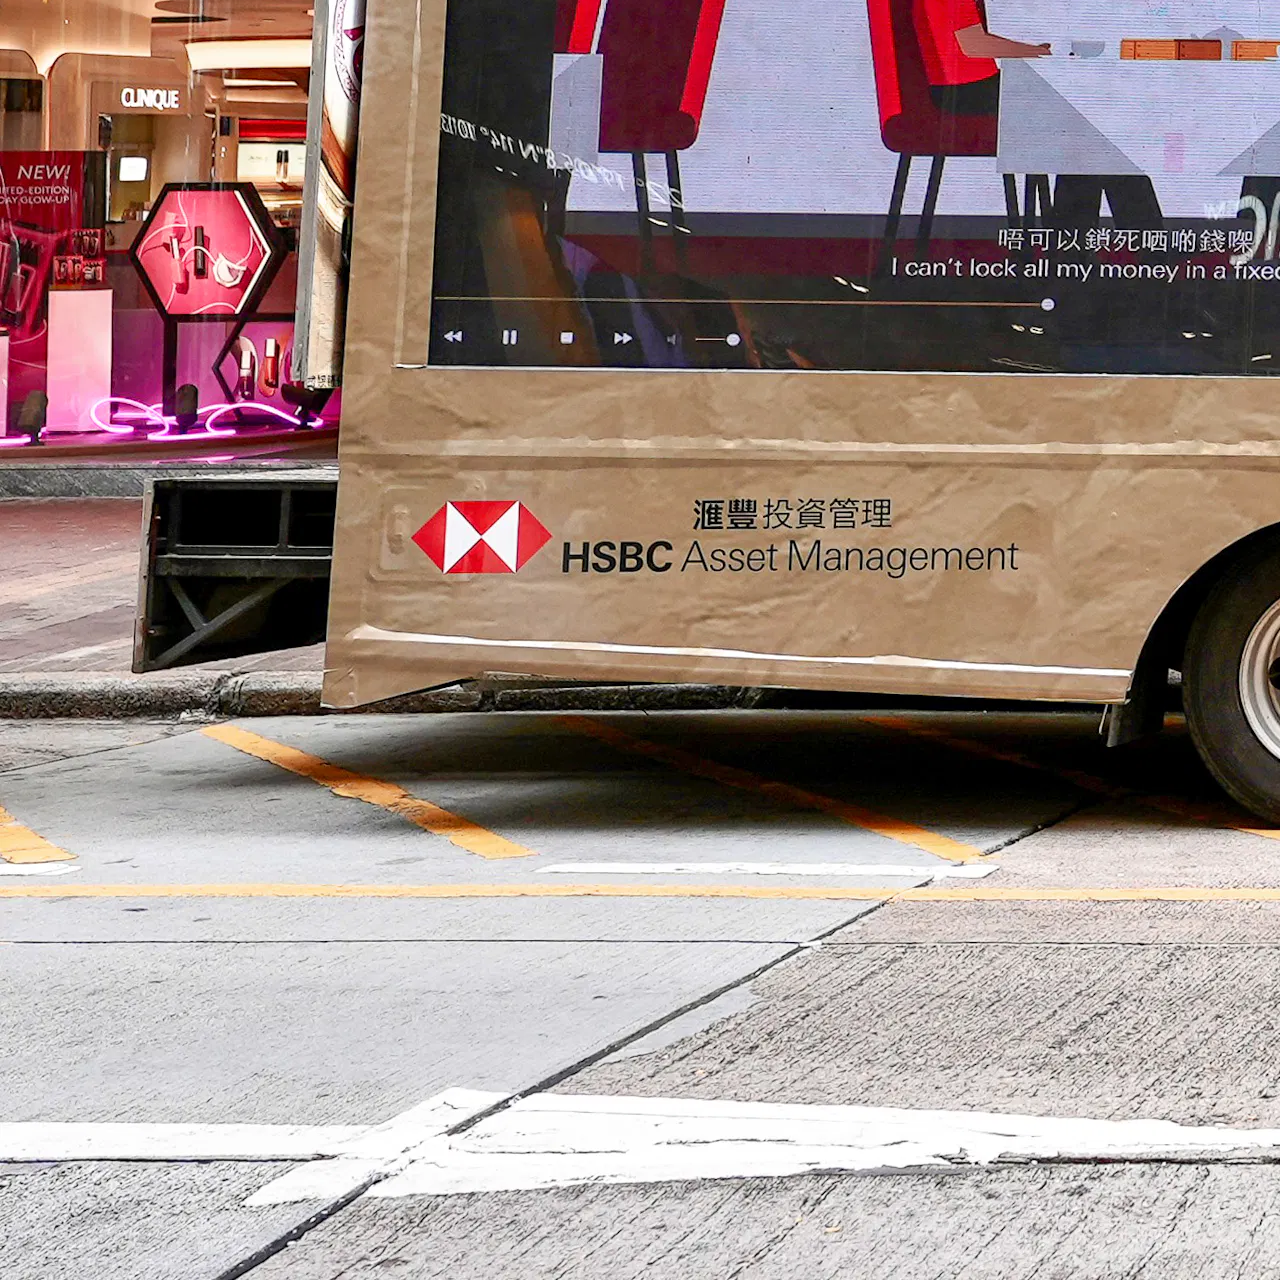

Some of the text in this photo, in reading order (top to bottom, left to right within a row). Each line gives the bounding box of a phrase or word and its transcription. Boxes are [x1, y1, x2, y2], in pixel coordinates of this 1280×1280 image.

[120, 87, 180, 110] CLINIQUE
[17, 165, 71, 180] NEW!
[20, 196, 70, 204] GLOW-UP
[892, 258, 897, 277] I
[970, 259, 1017, 278] lock
[1024, 259, 1049, 278] all
[1056, 264, 1091, 284] my
[1099, 265, 1180, 284] money
[1185, 260, 1206, 279] in
[1213, 265, 1227, 280] a
[562, 539, 1019, 579] HSBC Asset Management
